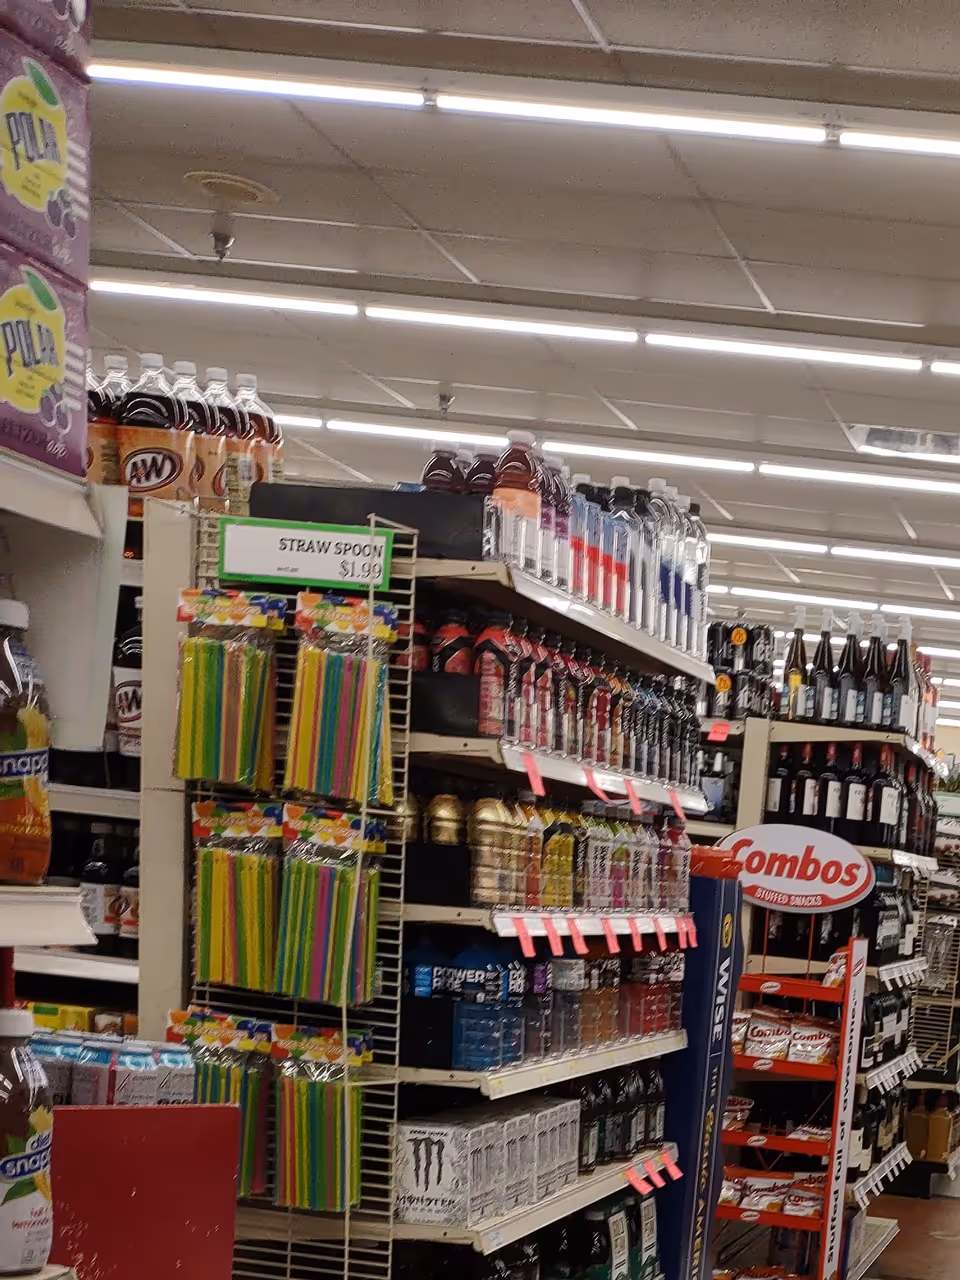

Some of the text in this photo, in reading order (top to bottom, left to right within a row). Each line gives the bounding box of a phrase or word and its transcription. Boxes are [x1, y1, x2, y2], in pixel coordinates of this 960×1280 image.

[278, 537, 384, 558] STRAW SPOON
[337, 559, 383, 580] $1.99
[730, 838, 864, 887] Combos
[753, 886, 823, 907] STUFFED SNACKS
[711, 956, 731, 1044] WISE
[708, 1065, 719, 1097] THE
[838, 1119, 847, 1138] of
[835, 1148, 844, 1182] full
[827, 1189, 840, 1265] Stuffed
